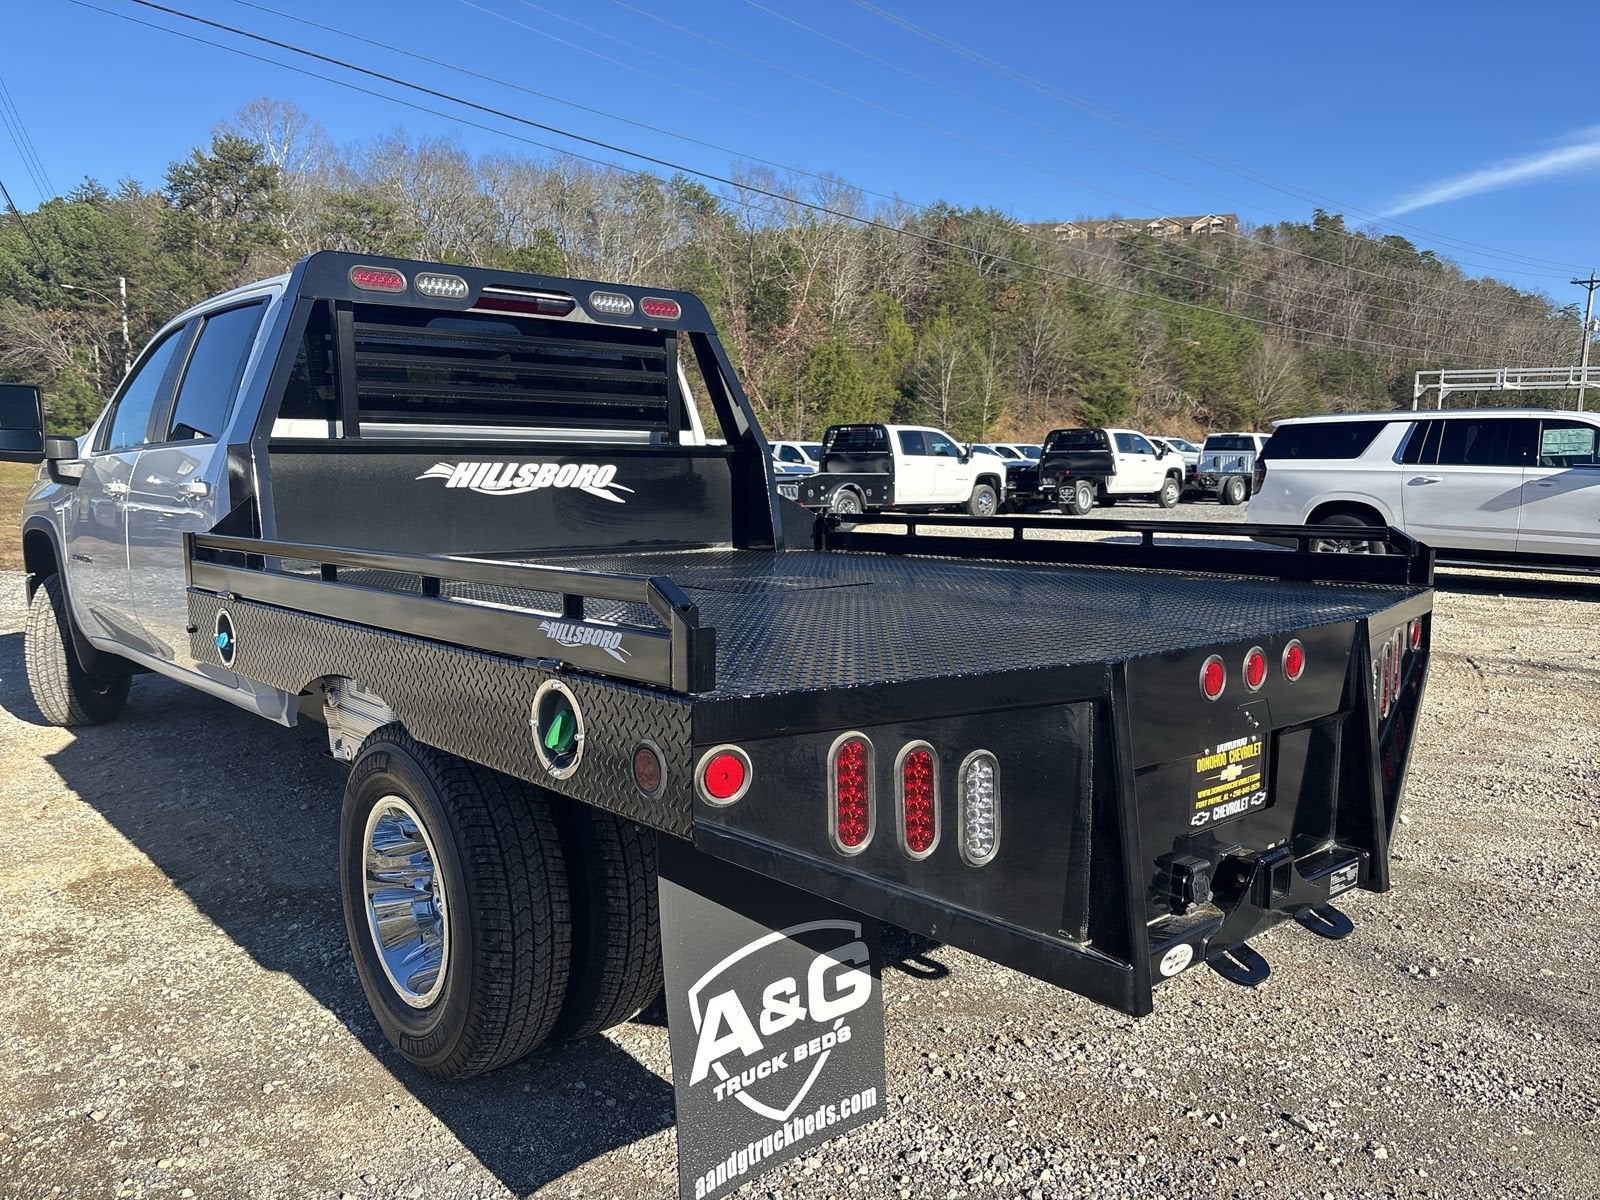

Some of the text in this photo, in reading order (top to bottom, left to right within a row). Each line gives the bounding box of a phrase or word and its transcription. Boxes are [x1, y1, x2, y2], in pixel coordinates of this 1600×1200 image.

[445, 462, 617, 489] HILLSBORO
[546, 621, 623, 650] HILLSBORO
[1196, 741, 1262, 773] DONOHOO CHEVROLET
[1212, 796, 1250, 820] CHEVROLET
[689, 941, 872, 1087] A&G
[713, 1051, 789, 1102] TRUCK
[694, 1086, 878, 1200] aandgtruckbeds.com
